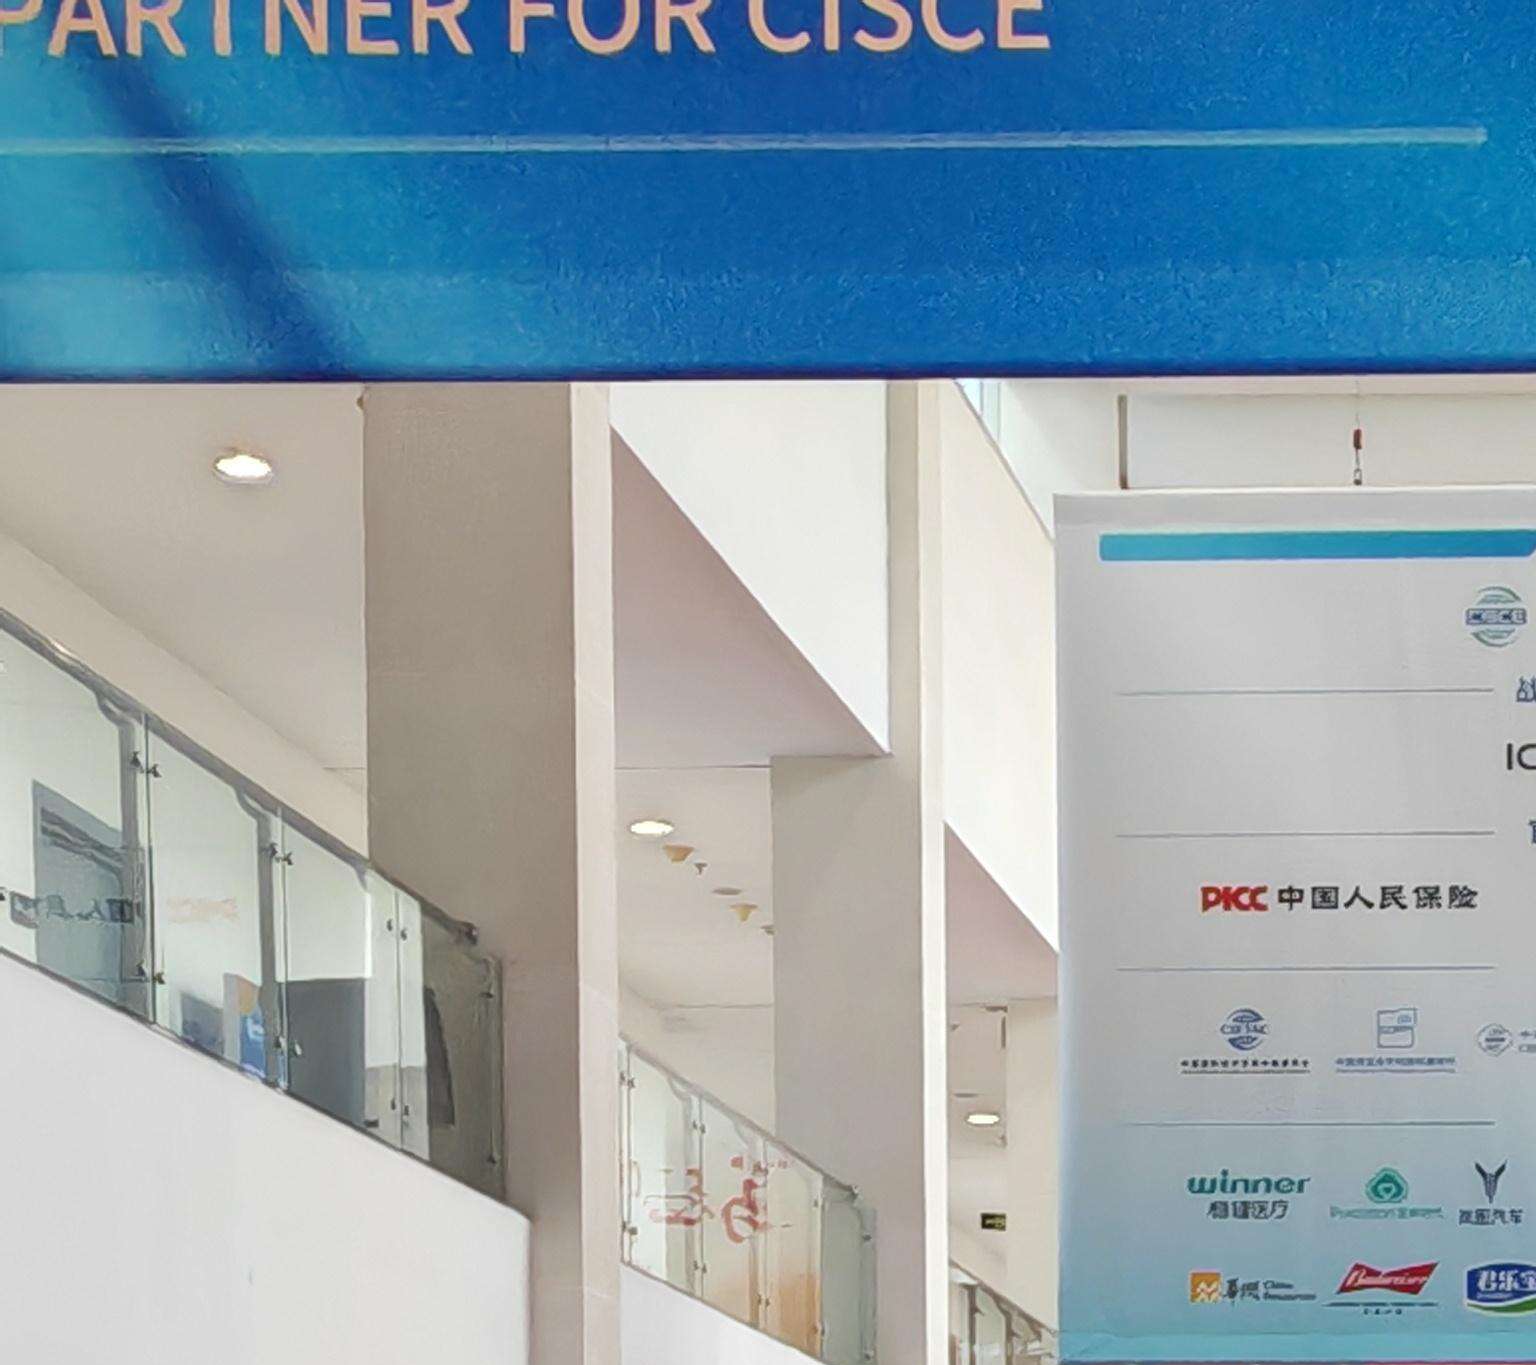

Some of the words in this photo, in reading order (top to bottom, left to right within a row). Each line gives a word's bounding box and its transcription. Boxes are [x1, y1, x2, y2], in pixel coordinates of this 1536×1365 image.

[509, 0, 716, 56] FOR
[747, 0, 1051, 54] CISCE
[1200, 885, 1269, 912] PICC
[1277, 884, 1479, 911] 中国人民保险
[1188, 1169, 1311, 1195] winner
